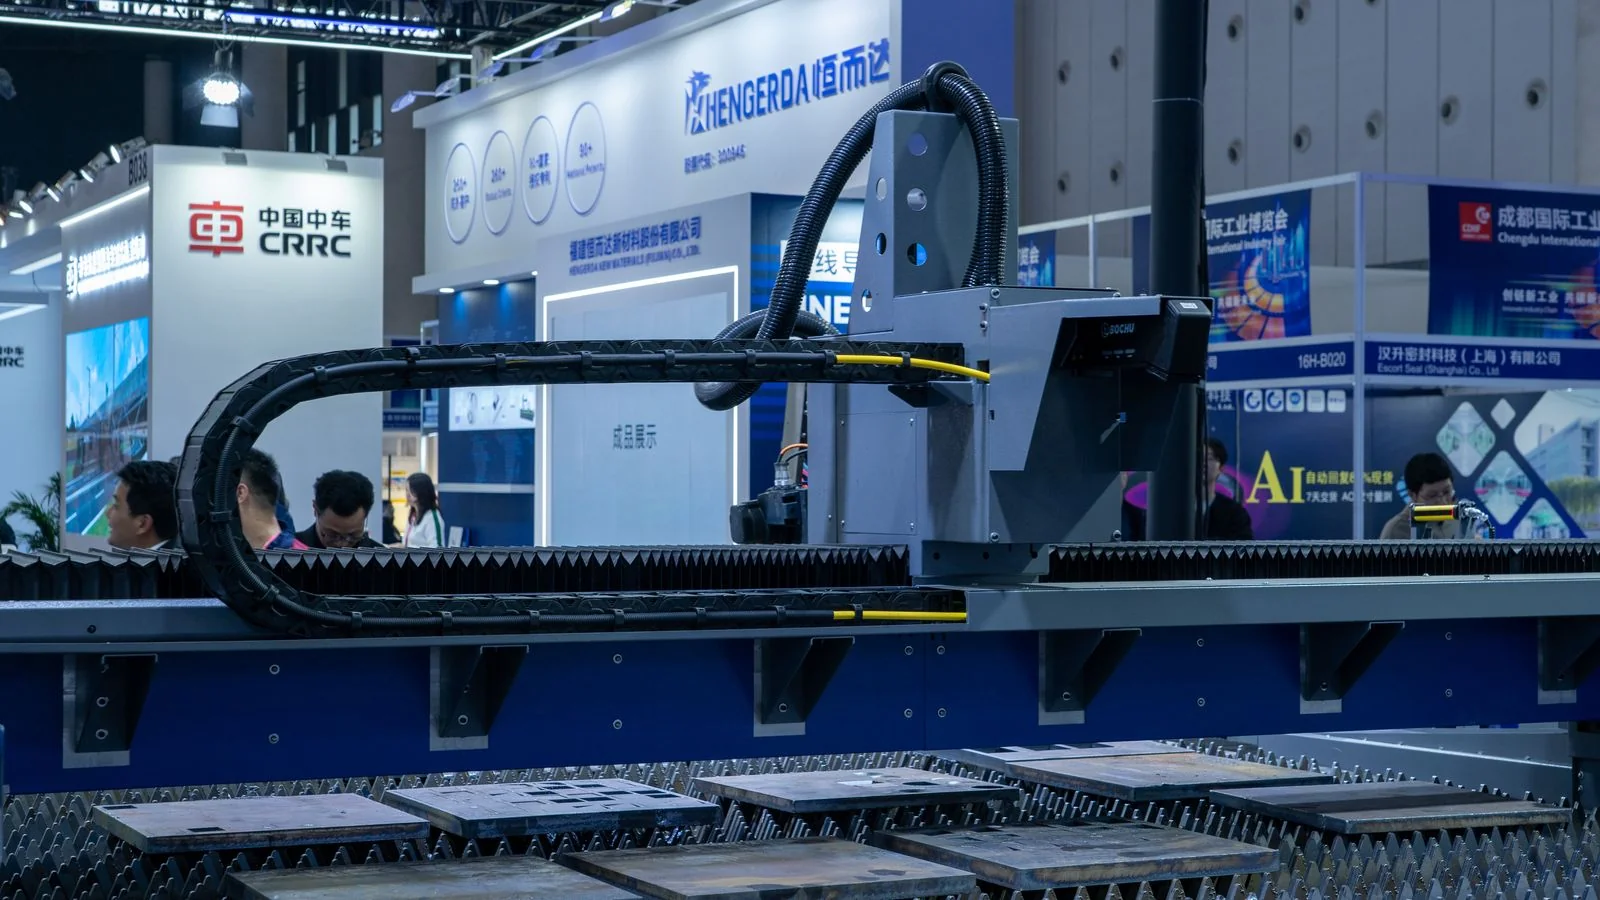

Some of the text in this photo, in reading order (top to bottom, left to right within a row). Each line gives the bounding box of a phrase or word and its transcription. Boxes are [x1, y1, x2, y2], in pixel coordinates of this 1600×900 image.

[813, 38, 890, 99] 恒而达
[706, 63, 810, 130] HENGERDA
[128, 151, 148, 186] B038
[258, 207, 351, 231] 中国中车
[1206, 208, 1288, 240] 际工业博览会
[1498, 205, 1600, 231] 成都国际工业
[258, 232, 352, 258] CRRC
[1498, 231, 1600, 247] Chengdu International
[815, 249, 858, 275] 线导
[1018, 245, 1040, 266] 览会
[801, 294, 851, 325] INE
[0, 345, 24, 356] 中车
[0, 357, 24, 368] RC
[1206, 355, 1218, 370] 司
[1298, 352, 1346, 368] 16H-B020
[1377, 363, 1403, 373] Escort
[1404, 363, 1423, 374] Seal
[1424, 364, 1468, 377] (Shanghai)
[612, 424, 657, 450] 成品展示
[1246, 450, 1305, 504] AI
